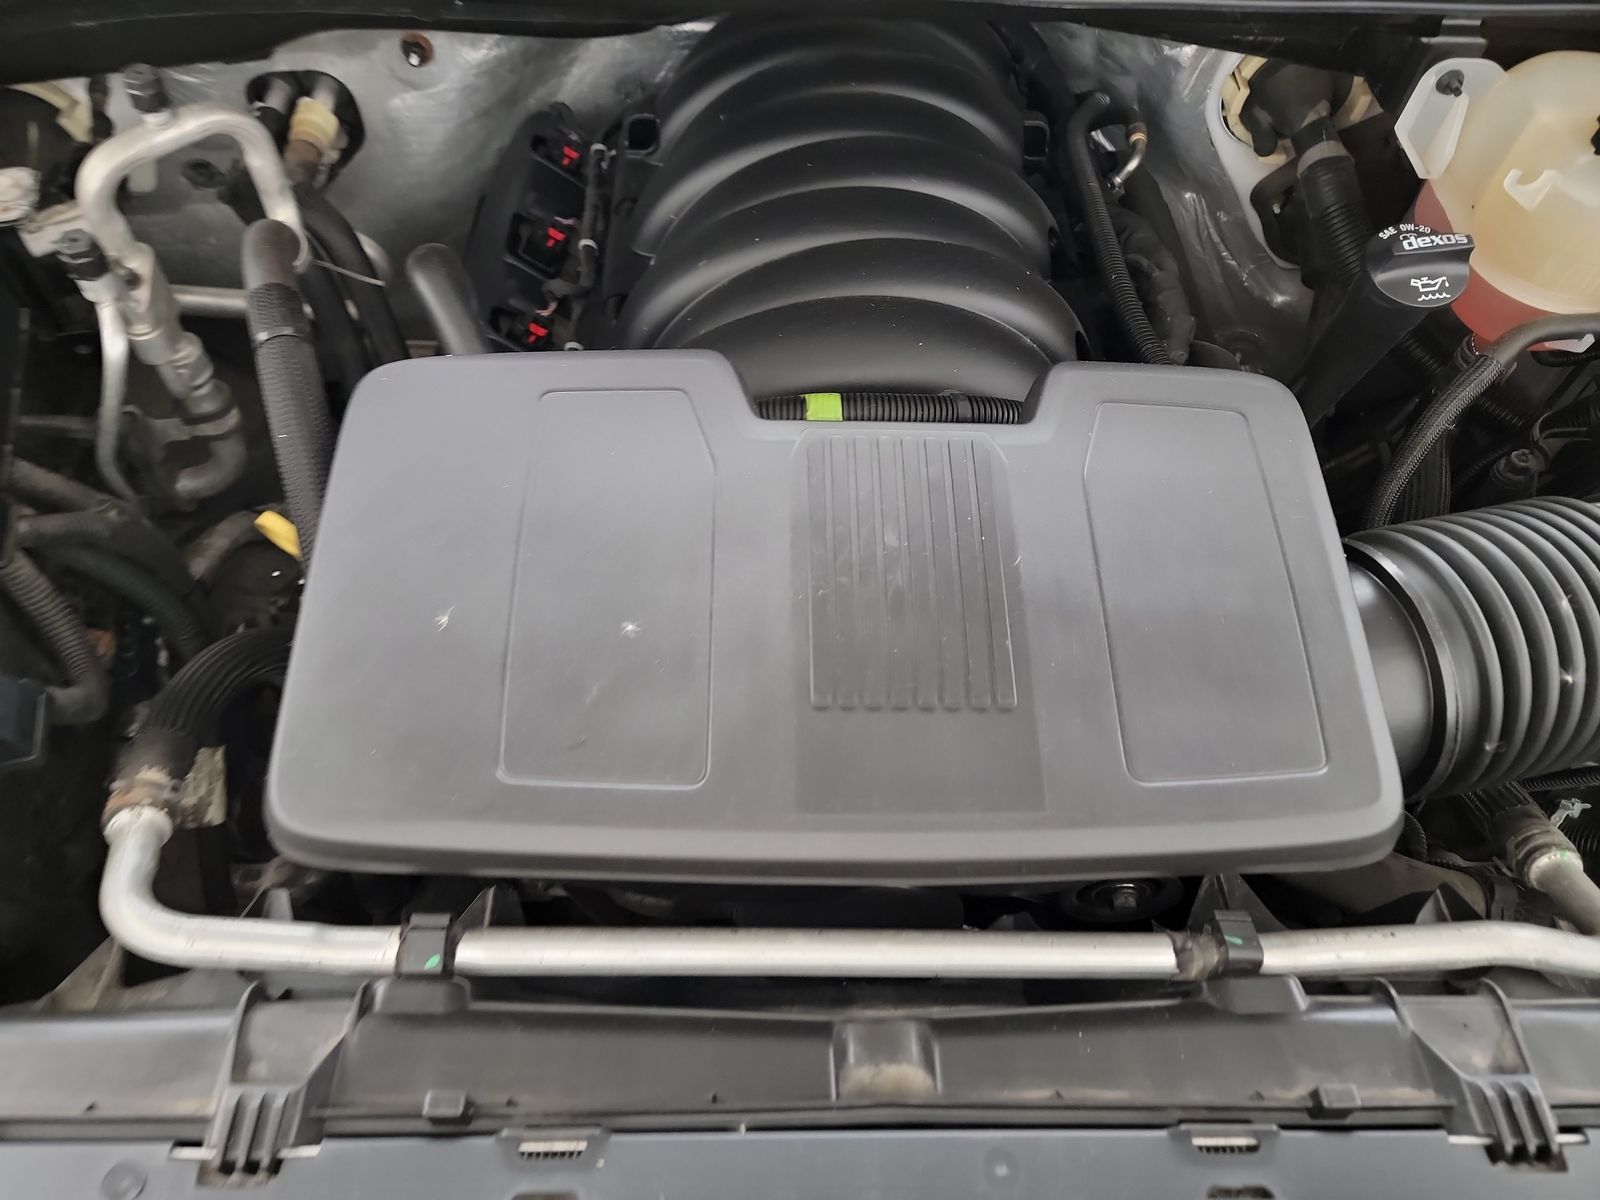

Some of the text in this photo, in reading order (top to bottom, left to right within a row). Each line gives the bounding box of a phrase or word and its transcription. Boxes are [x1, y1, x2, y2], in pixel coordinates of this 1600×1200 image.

[1379, 223, 1431, 240] SAE 0W-20
[1402, 233, 1468, 251] dexos
